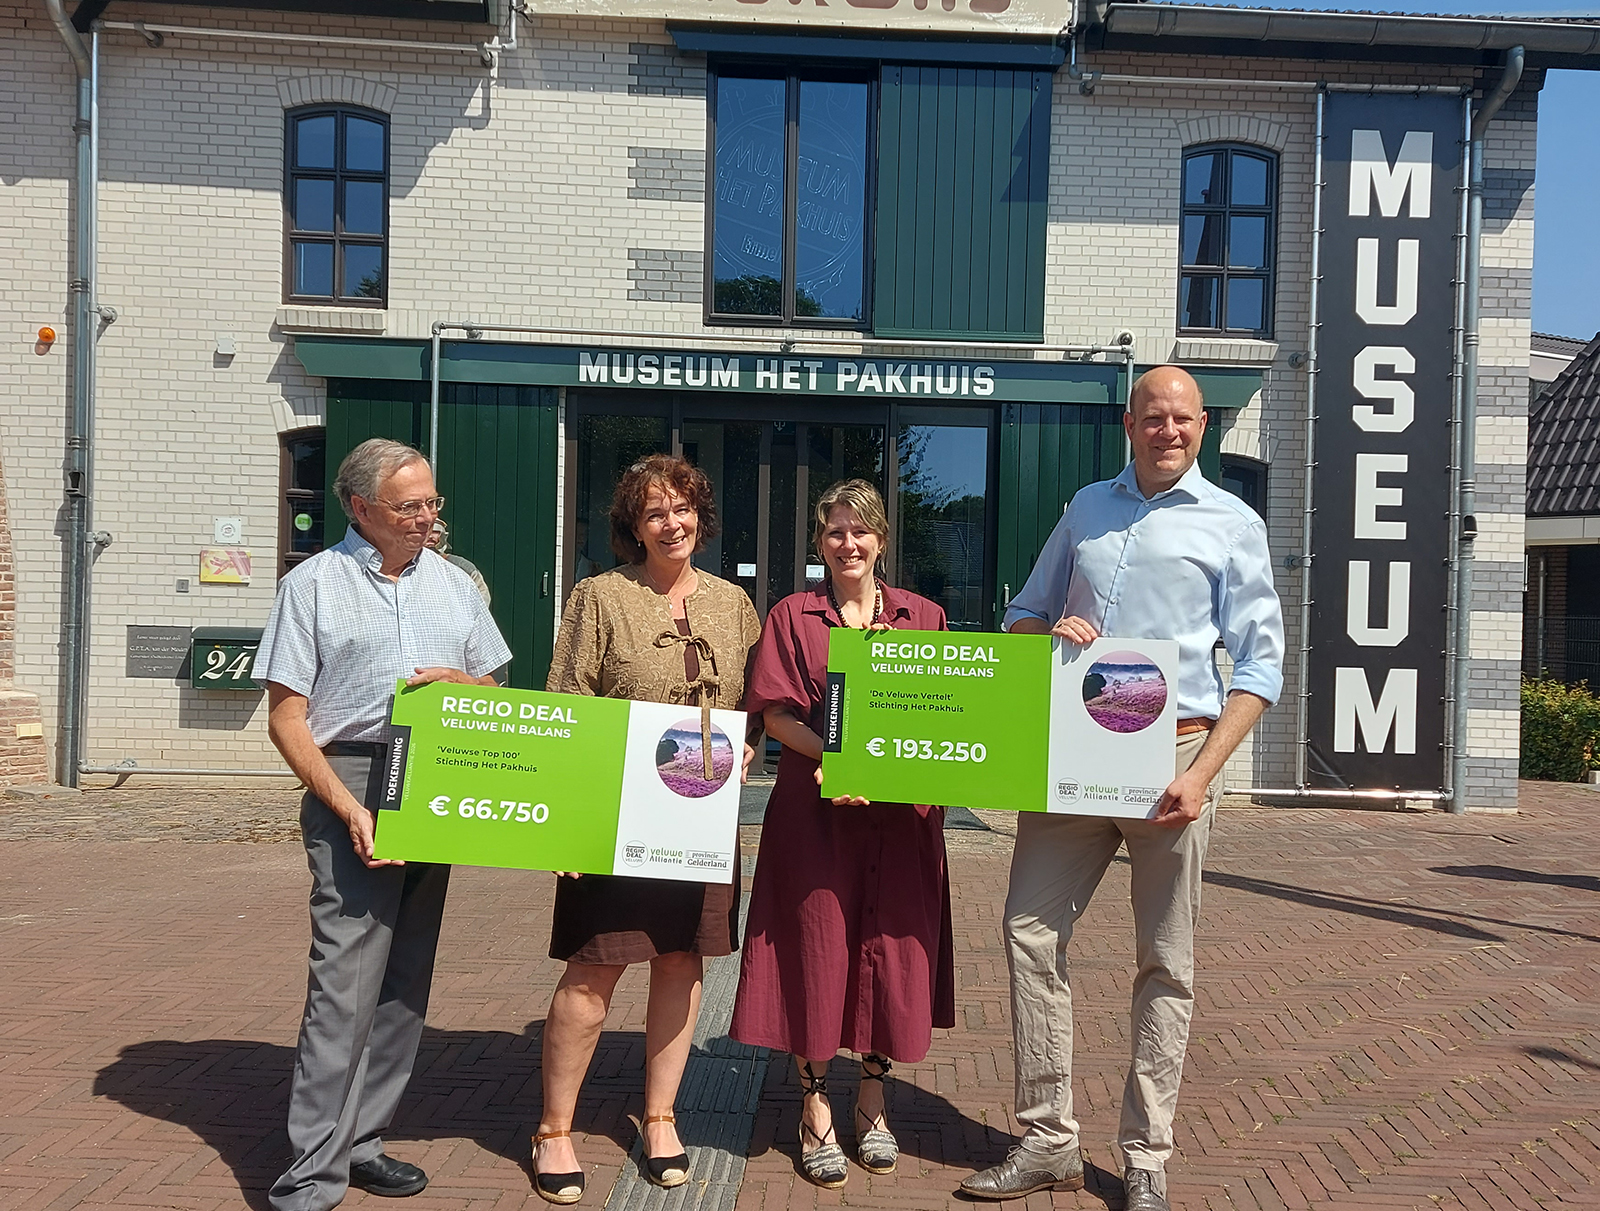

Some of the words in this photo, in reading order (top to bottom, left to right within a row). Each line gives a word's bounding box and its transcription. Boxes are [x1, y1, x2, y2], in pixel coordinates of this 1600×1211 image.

[725, 135, 851, 206] MUSEUM
[716, 166, 756, 208] HET
[578, 352, 740, 388] MUSEUM
[755, 359, 823, 391] HET
[837, 361, 995, 396] PAKHUIS
[1333, 129, 1434, 754] MUSEUM
[871, 642, 936, 660] REGIO
[943, 645, 1000, 662] DEAL
[199, 650, 251, 680] 24
[871, 663, 924, 674] VELUWE
[927, 665, 940, 675] IN
[943, 666, 994, 678] BALANS
[869, 689, 884, 697] 'De
[886, 690, 919, 699] Veluwe
[920, 692, 954, 701] Vertelt'
[441, 696, 512, 717] REGIO
[519, 703, 578, 724] DEAL
[828, 683, 840, 745] TOEKENNING
[869, 701, 908, 711] Stichting
[911, 703, 927, 711] Het
[929, 704, 964, 713] Pakhuis
[441, 717, 498, 731] VELUWE
[501, 723, 515, 733] IN
[518, 725, 571, 738] BALANS
[437, 745, 480, 756] 'Veluwse
[482, 749, 500, 759] Top
[865, 737, 886, 758] €
[892, 738, 987, 763] 193.250
[386, 737, 404, 802] TOEKENNING
[435, 757, 479, 769] Stichting
[481, 761, 498, 770] Het
[500, 762, 538, 773] Pakhuis
[1083, 784, 1119, 793] veluwe
[1083, 793, 1119, 801] Alliantie
[428, 795, 450, 817] €
[458, 797, 550, 824] 66.750
[649, 855, 683, 864] Alliantie
[650, 847, 683, 857] veluwe
[691, 851, 719, 859] provincie
[687, 858, 727, 868] Gelderland
